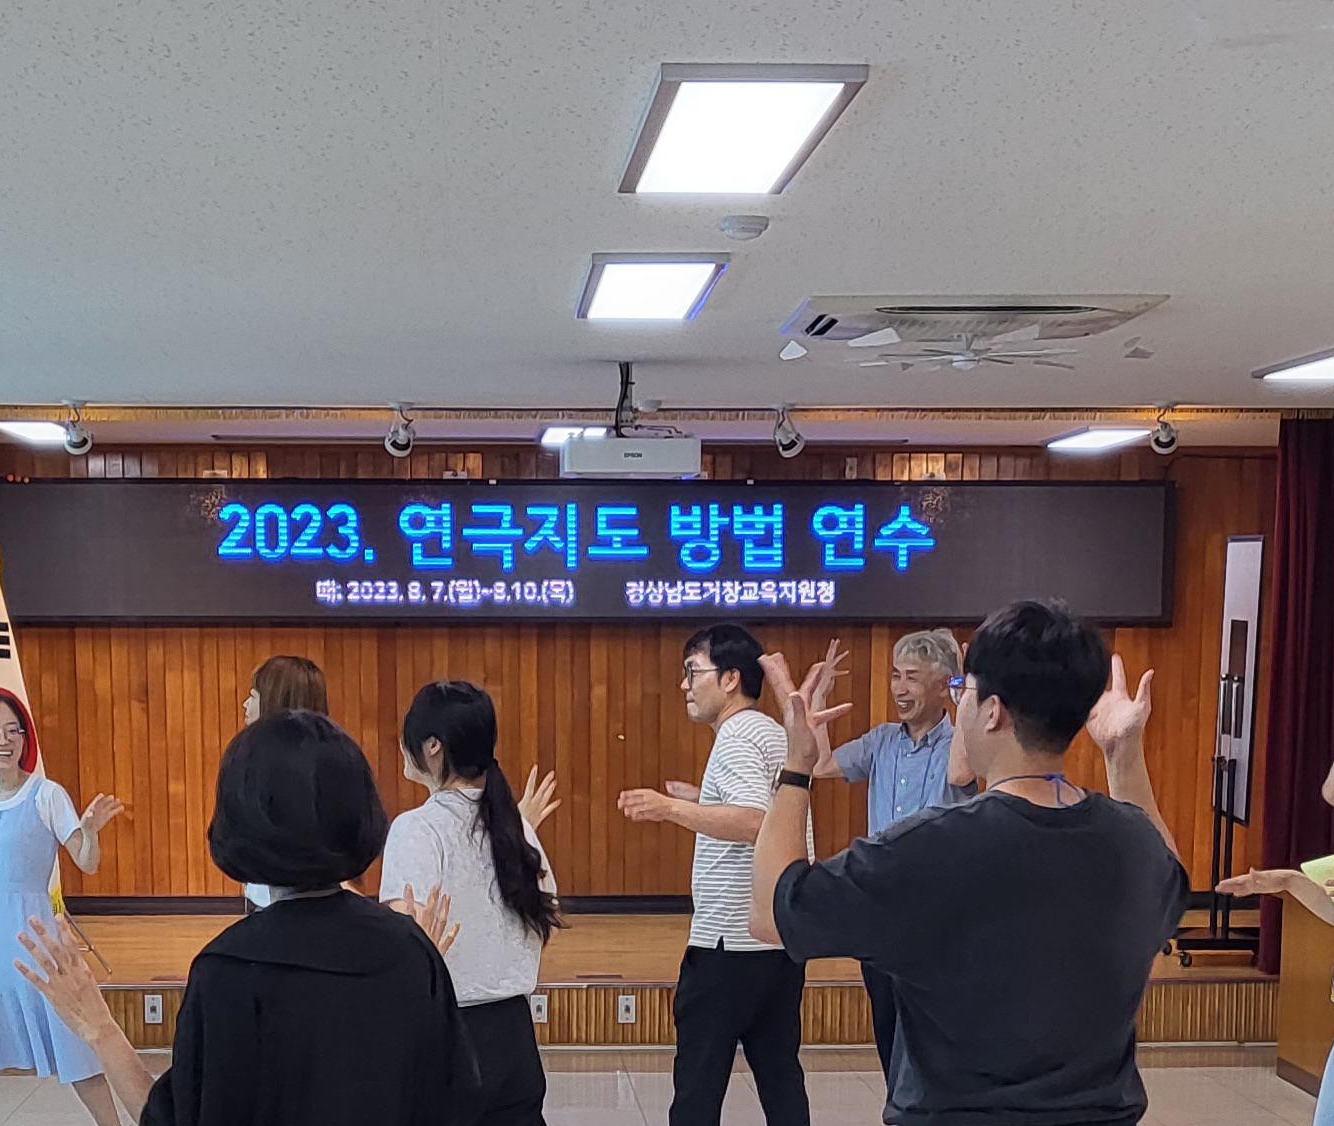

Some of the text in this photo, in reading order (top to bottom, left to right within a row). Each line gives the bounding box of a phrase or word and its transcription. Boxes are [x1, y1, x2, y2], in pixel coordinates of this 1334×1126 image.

[217, 502, 936, 570] 2023. 연극지도 방법 연수
[625, 579, 836, 605] 경상남도거창교육지원청
